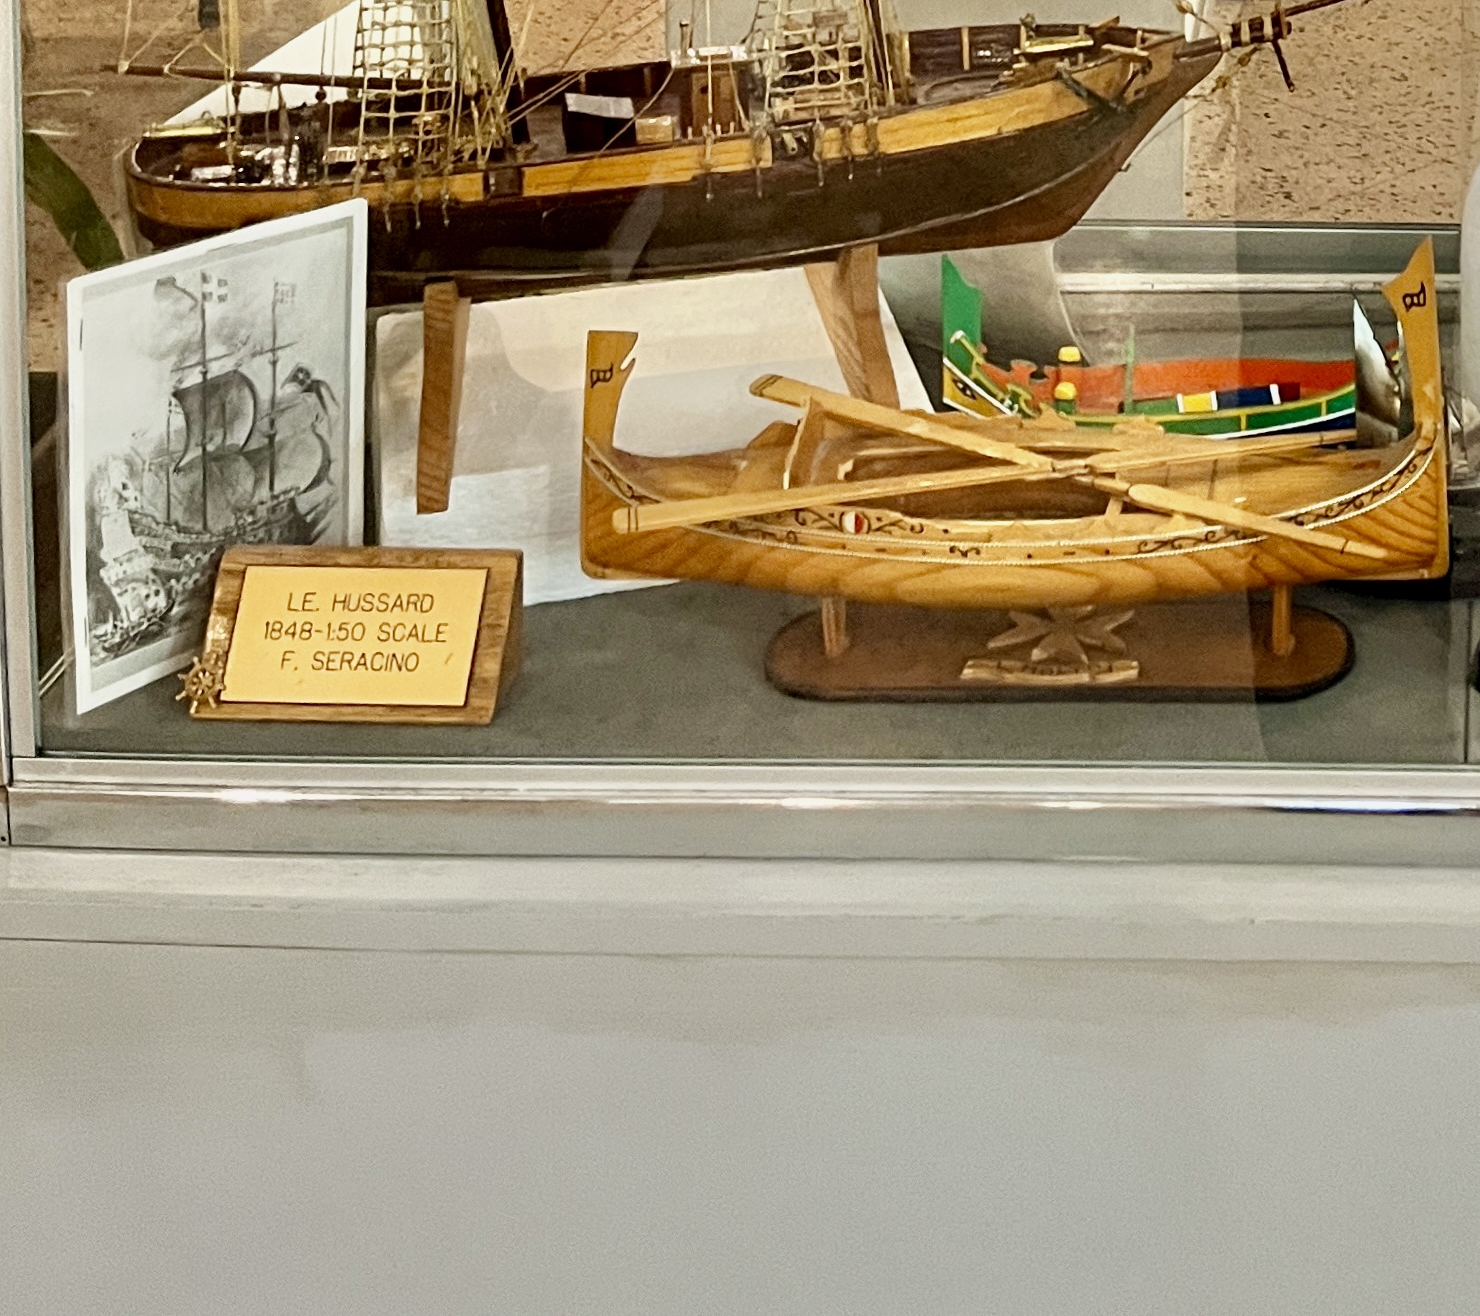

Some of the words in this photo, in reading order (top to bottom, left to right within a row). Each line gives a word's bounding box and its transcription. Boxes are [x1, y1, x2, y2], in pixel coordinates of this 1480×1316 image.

[286, 591, 320, 612] LE.
[331, 592, 434, 613] HUSSARD
[376, 623, 448, 643] SCALE
[280, 650, 299, 671] F.
[311, 652, 420, 672] SERACINO
